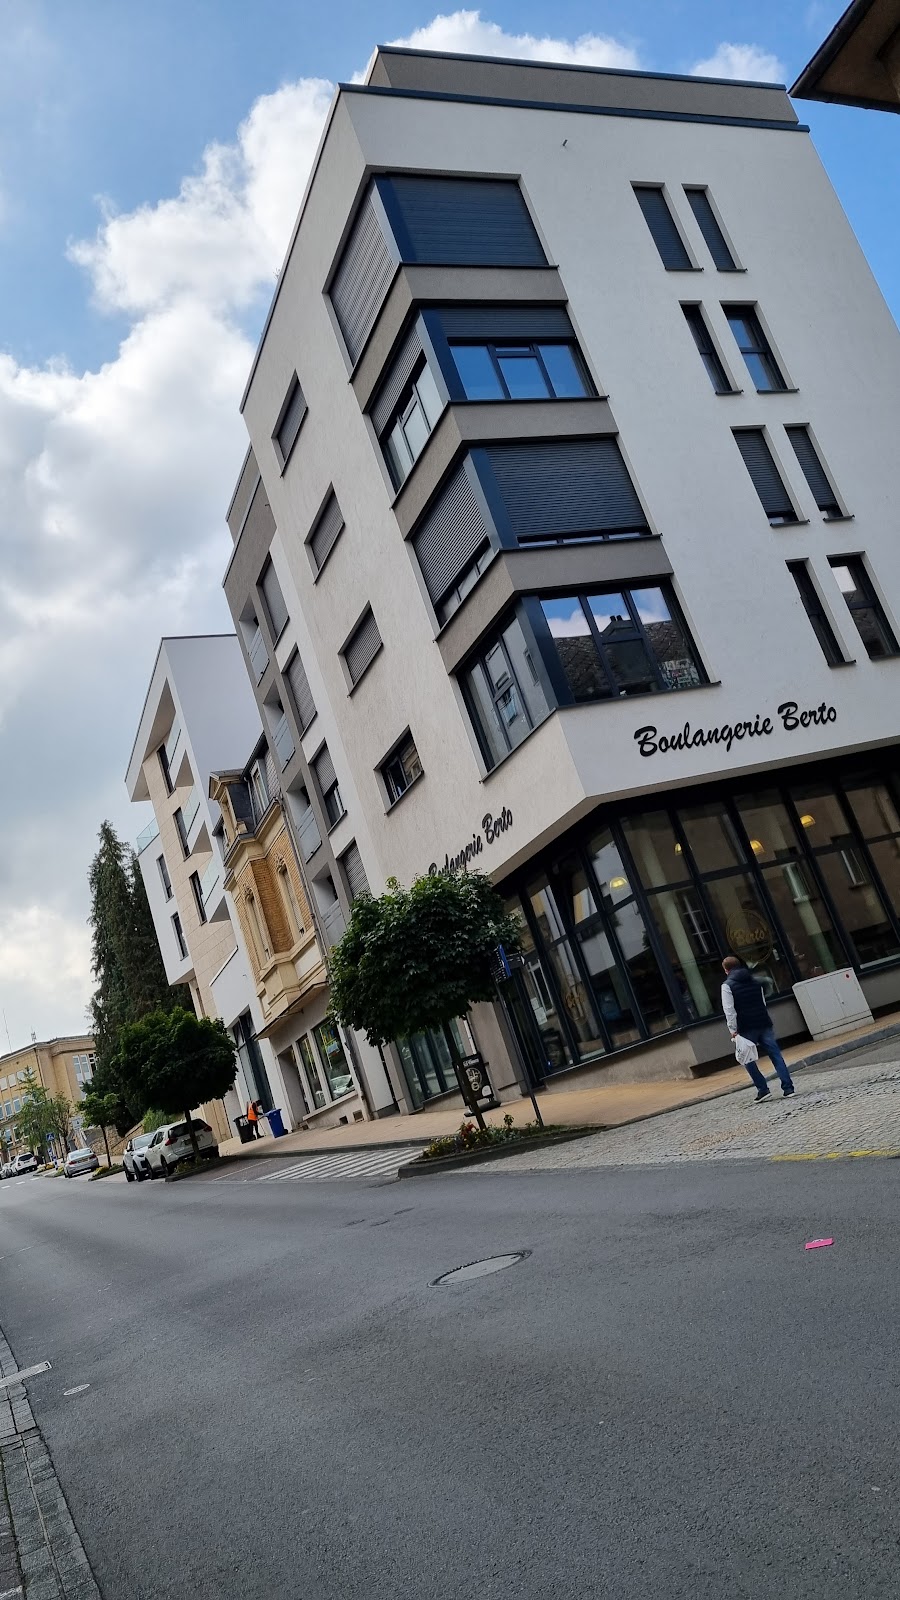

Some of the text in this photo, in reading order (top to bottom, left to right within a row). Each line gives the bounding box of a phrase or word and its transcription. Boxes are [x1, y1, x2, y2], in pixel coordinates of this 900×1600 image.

[633, 701, 837, 757] Boulangerie Berto
[481, 806, 513, 845] Berto
